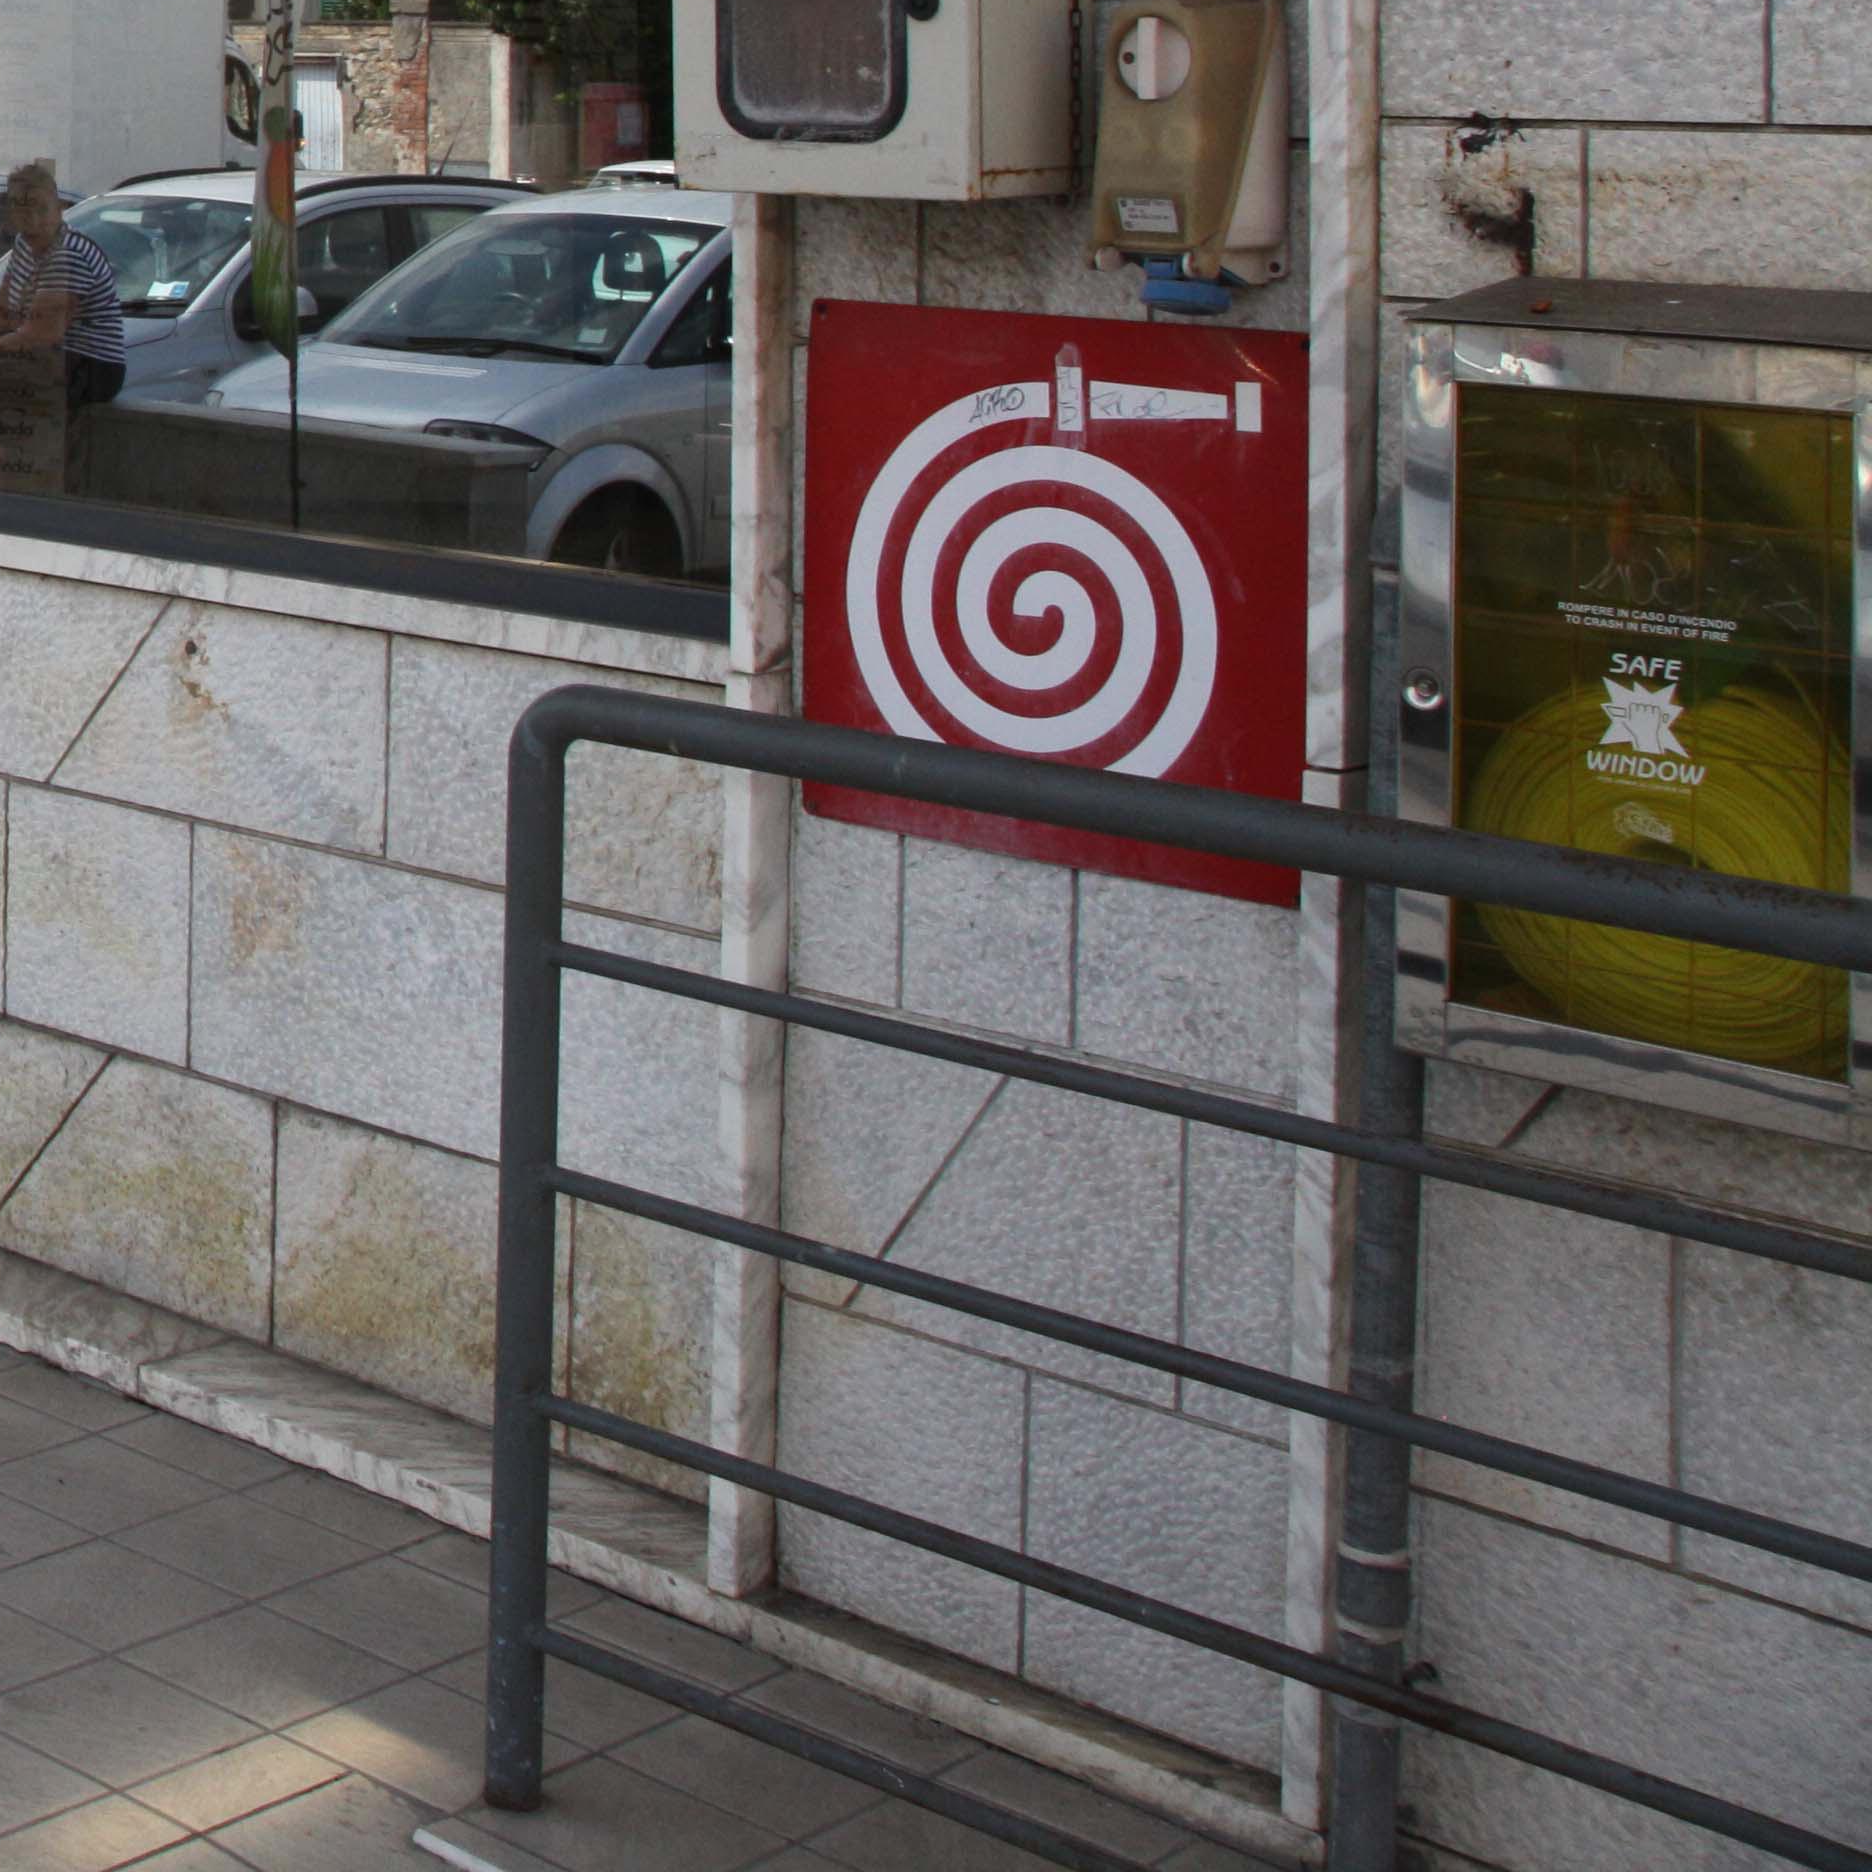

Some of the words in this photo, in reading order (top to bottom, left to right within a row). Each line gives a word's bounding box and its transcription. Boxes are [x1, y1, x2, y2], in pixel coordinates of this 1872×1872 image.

[1557, 601, 1615, 617] ROMPERE
[1616, 607, 1629, 619] IN
[1631, 609, 1665, 623] CASO
[1667, 613, 1737, 631] D'INCENDIO
[1565, 614, 1580, 625] TO
[1583, 616, 1624, 629] CRASH
[1626, 621, 1639, 632] IN
[1641, 623, 1680, 636] EVENT
[1682, 627, 1699, 639] OF
[1701, 630, 1729, 643] FIRE
[1609, 652, 1683, 681] SAFE
[1586, 749, 1706, 785] WINDOW
